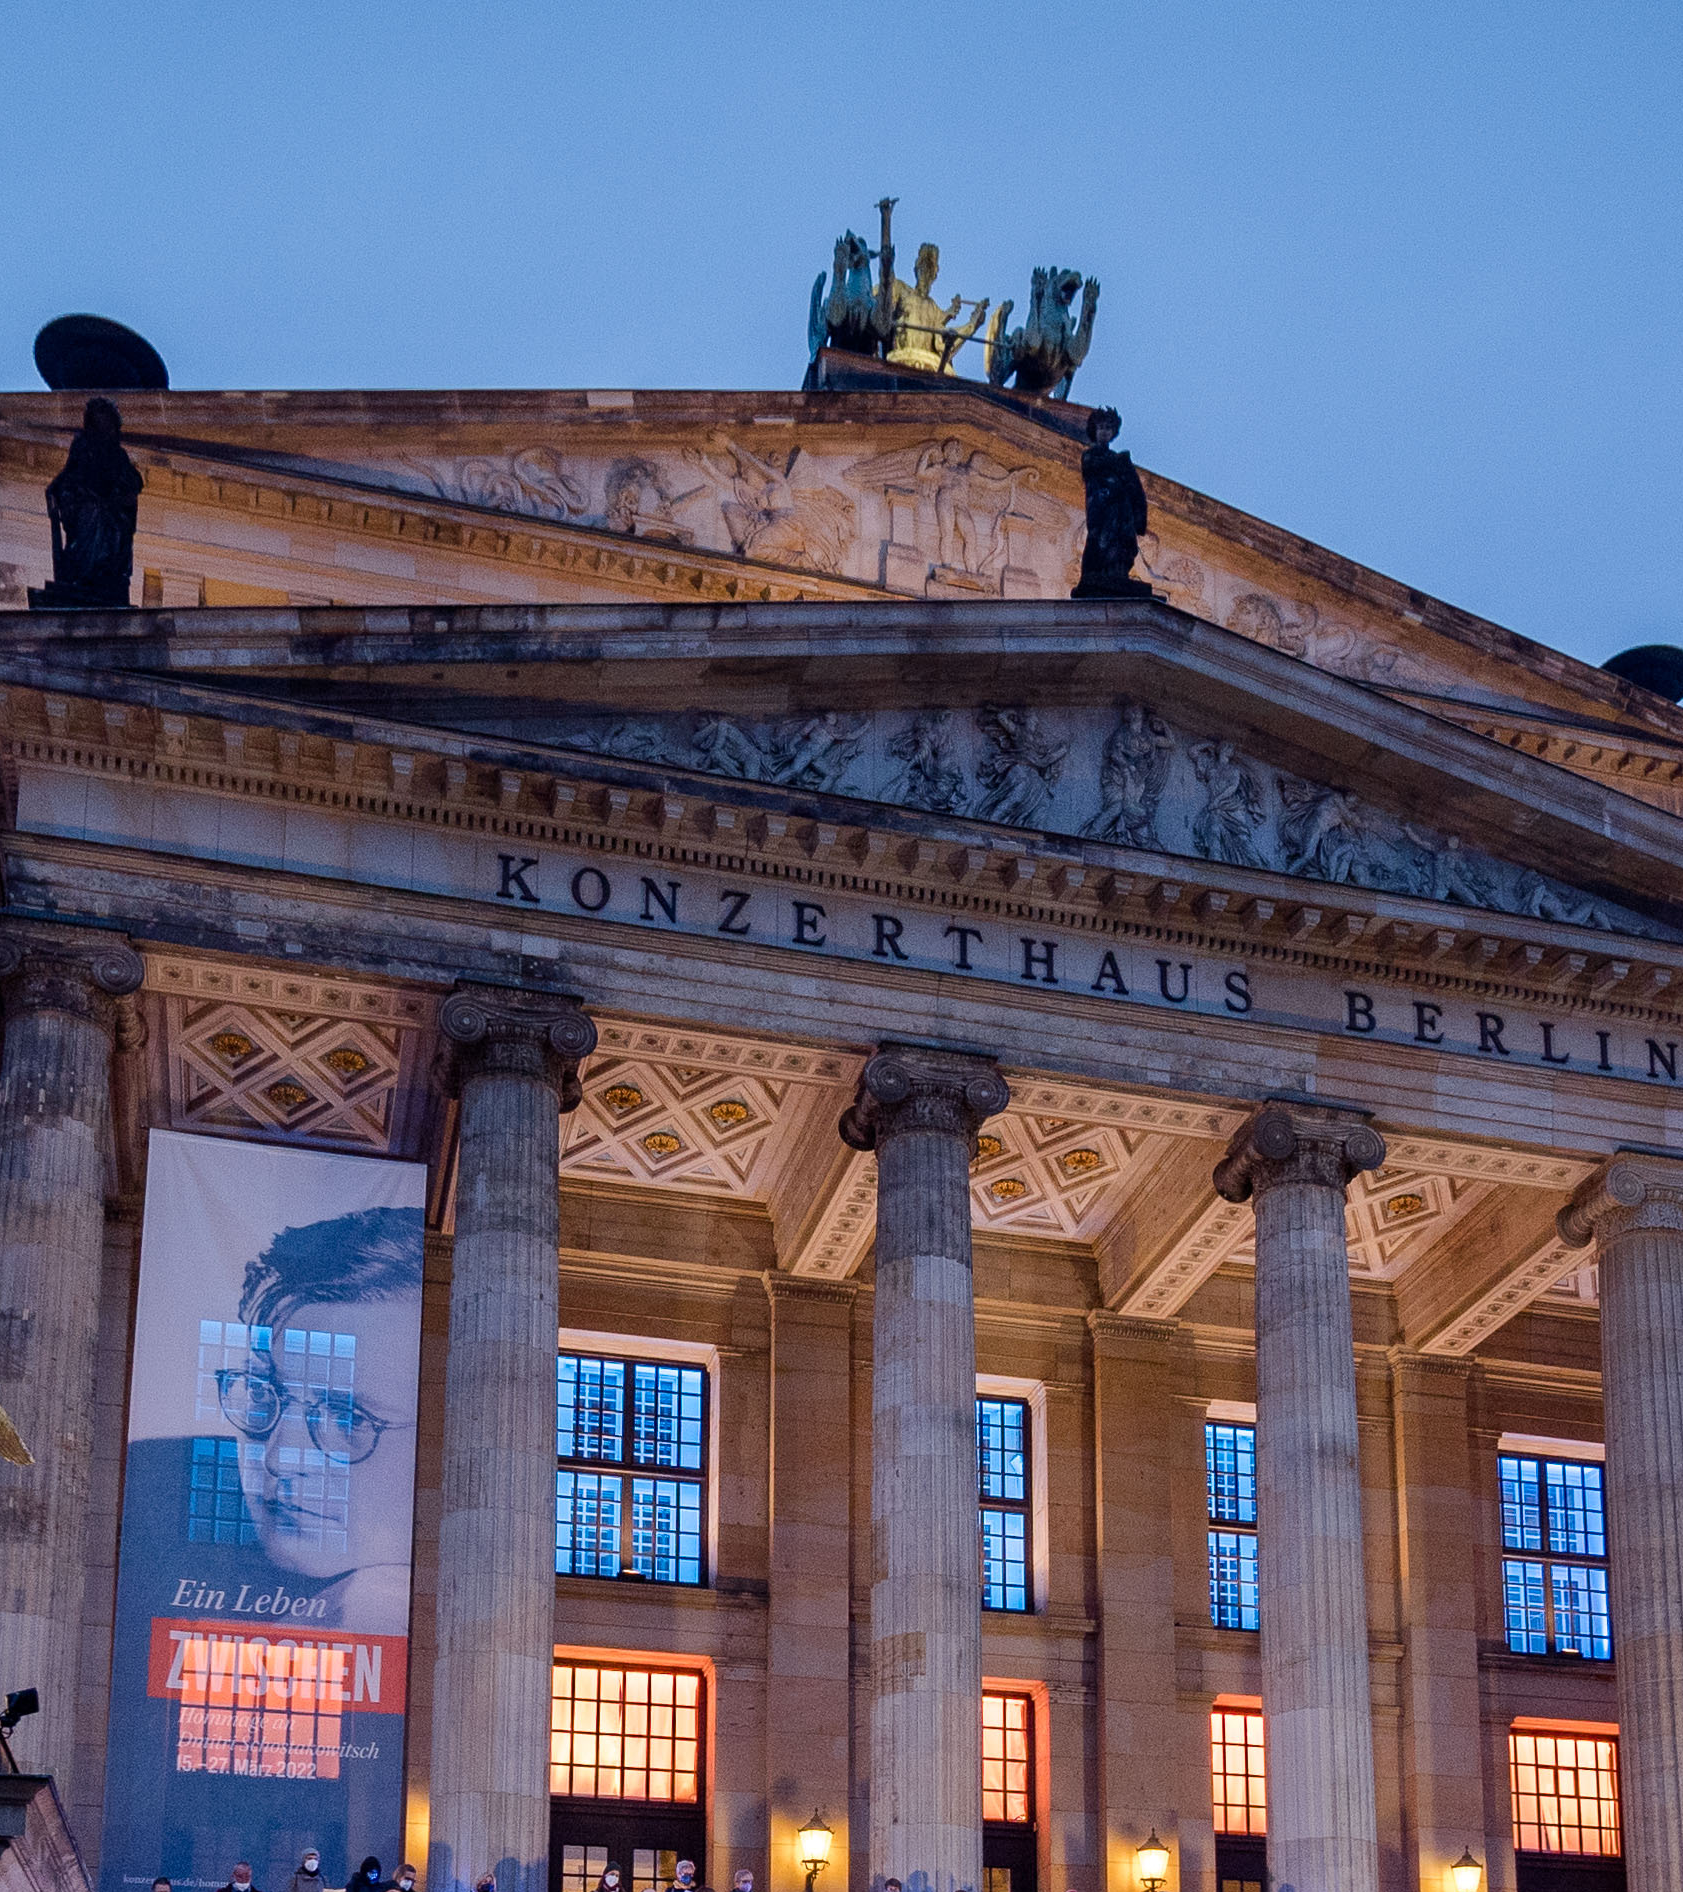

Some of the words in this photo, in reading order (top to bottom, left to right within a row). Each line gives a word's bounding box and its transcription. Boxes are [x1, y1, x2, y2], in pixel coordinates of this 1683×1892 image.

[496, 853, 1254, 1014] KONZERTHAUS
[1344, 990, 1679, 1081] BERLIN
[170, 1578, 227, 1611] Ein
[231, 1584, 328, 1619] Leben
[165, 1629, 383, 1703] ZWISCHEN
[233, 1758, 273, 1777] März
[276, 1761, 318, 1780] 2022
